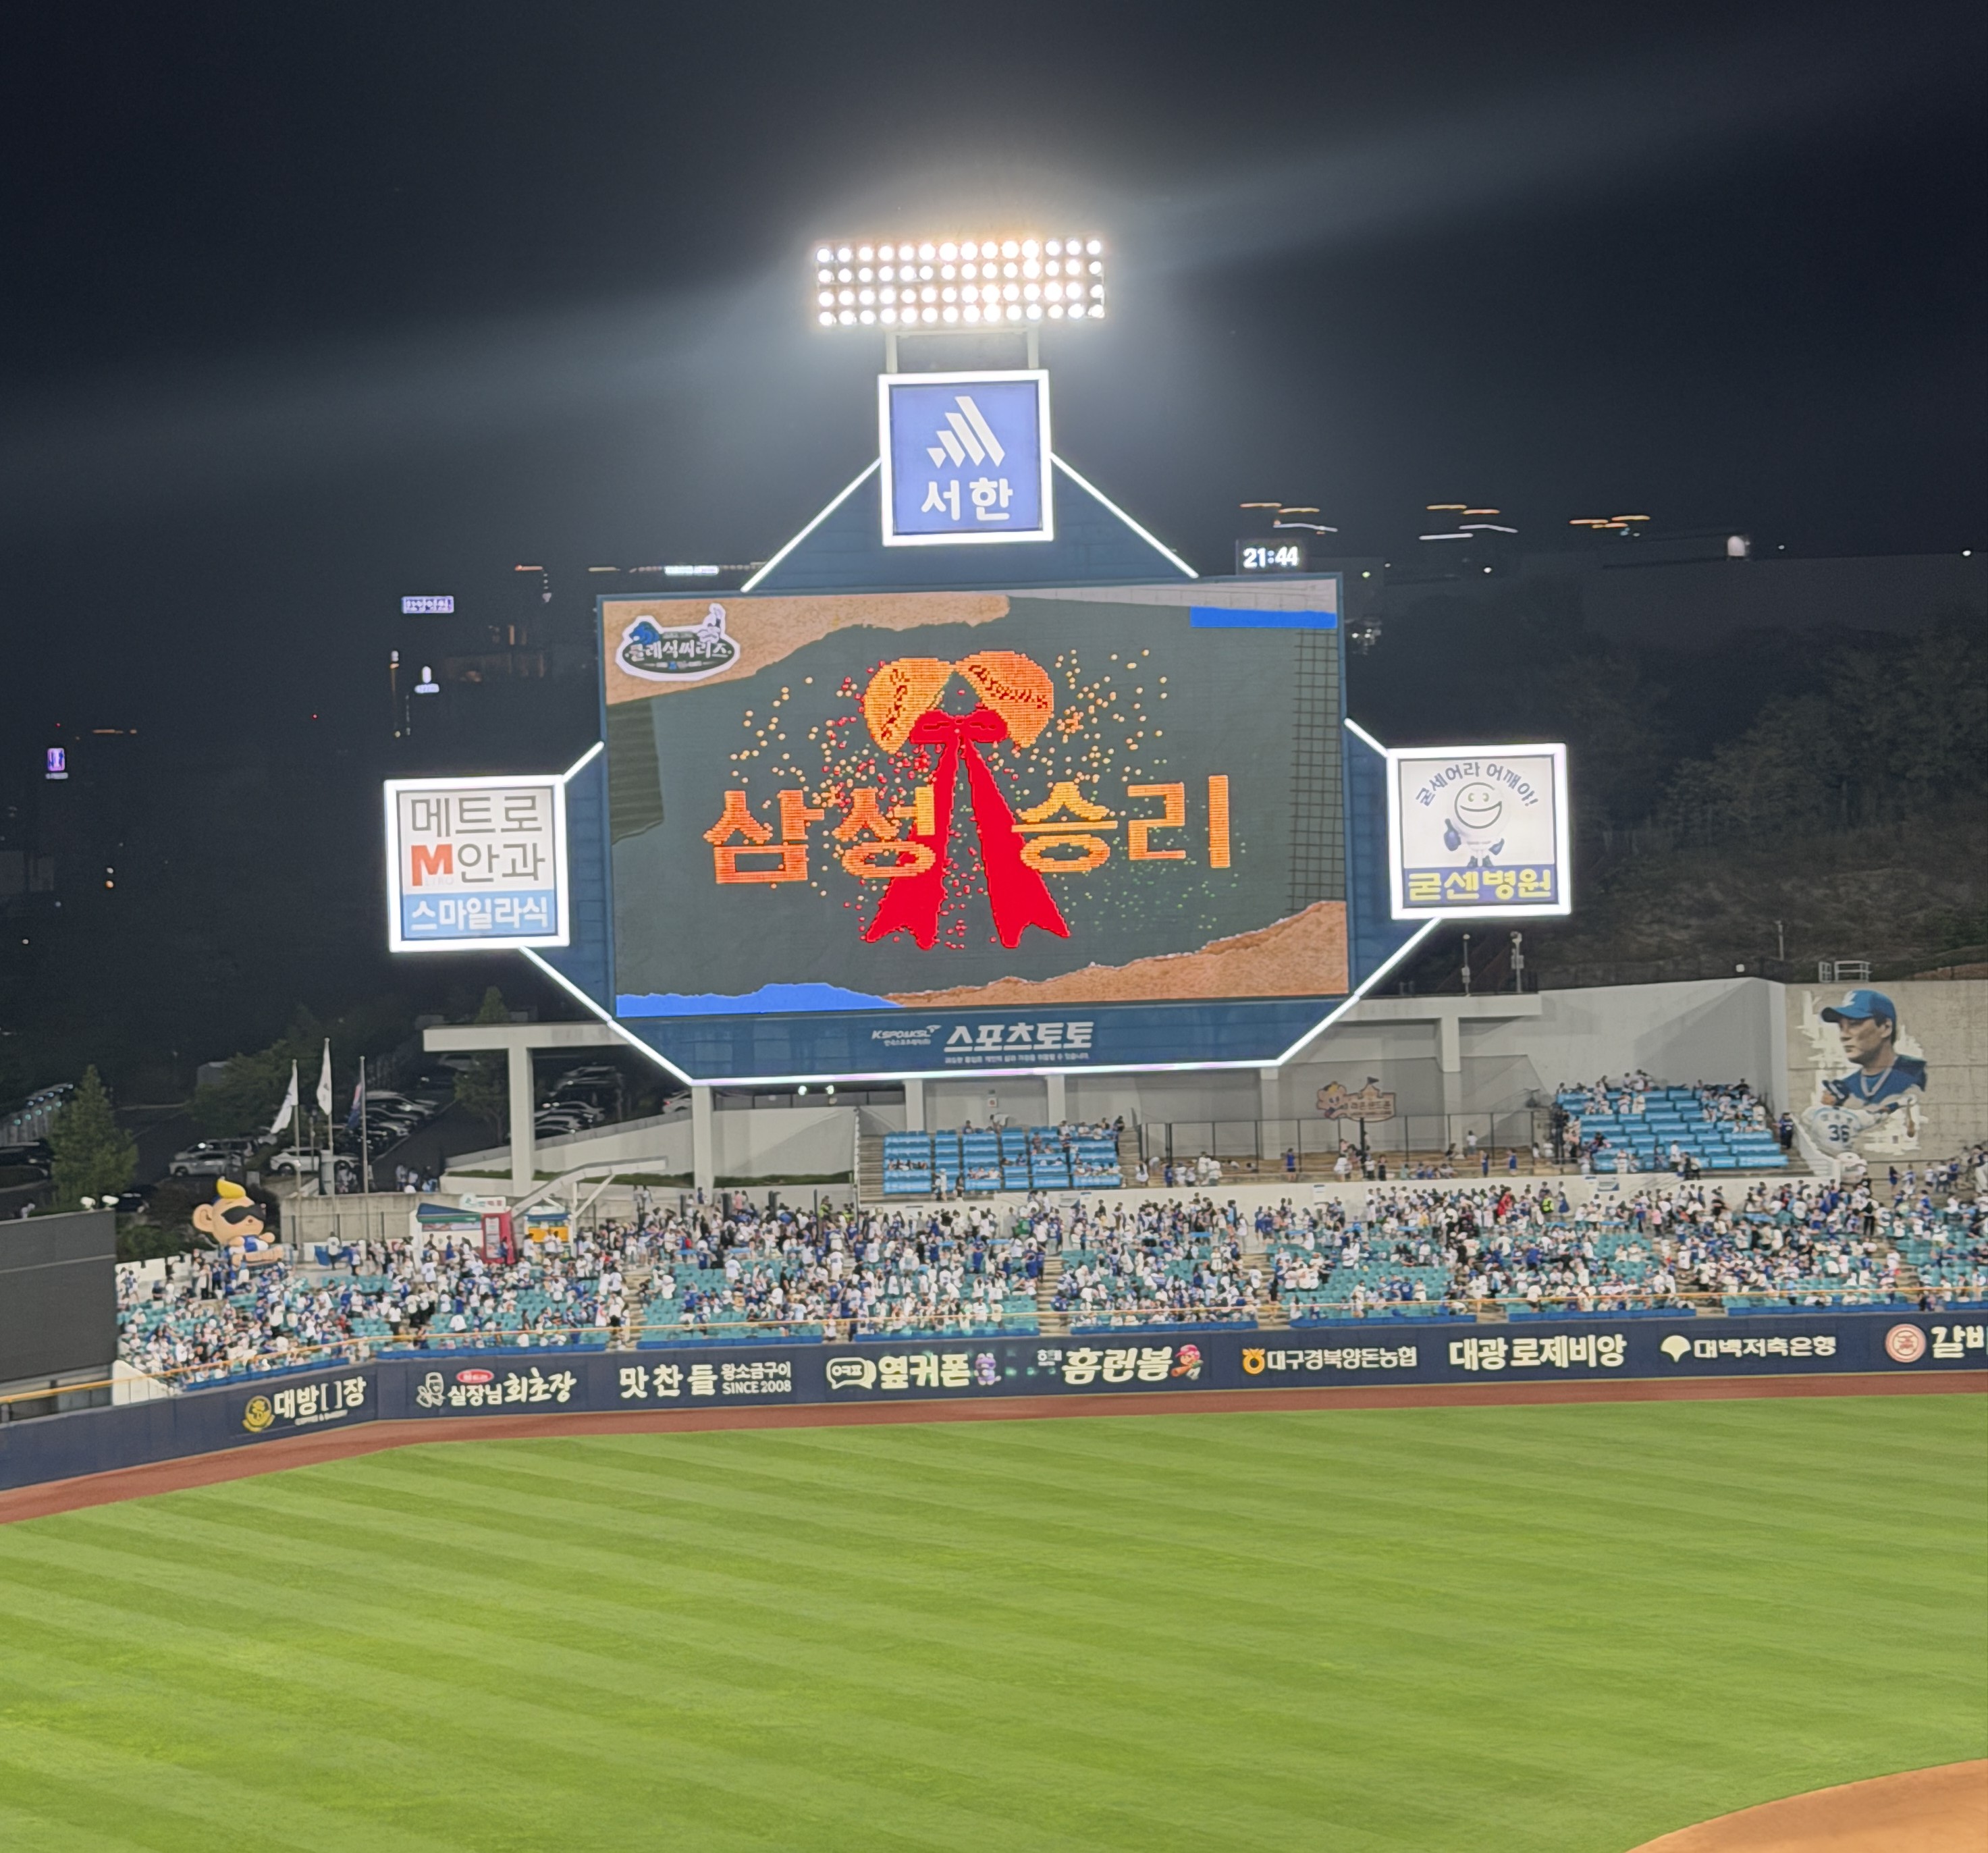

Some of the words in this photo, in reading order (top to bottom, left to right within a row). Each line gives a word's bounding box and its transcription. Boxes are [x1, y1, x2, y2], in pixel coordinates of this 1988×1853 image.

[921, 477, 1013, 521] 서한
[1243, 545, 1299, 568] 21:44
[1416, 762, 1480, 807] 굳세어라
[1486, 763, 1538, 807] 어깨야!
[411, 795, 543, 837] 메트로
[703, 785, 937, 884] 삼성
[1011, 774, 1231, 873] 승리
[1408, 869, 1551, 901] 굳센병원
[411, 896, 547, 930] 스마일라식
[944, 1021, 1094, 1052] 스포츠토토
[1828, 1124, 1850, 1142] 36
[878, 1353, 971, 1389] 옆커폰
[1061, 1346, 1173, 1384] 홈런볼
[1267, 1346, 1417, 1370] 대구경북양돈농협
[448, 1384, 502, 1406] 실장님
[619, 1364, 718, 1398] 맛찬들
[721, 1361, 791, 1380] 왕소금구이
[722, 1380, 759, 1395] SINCE
[760, 1380, 792, 1393] 2008
